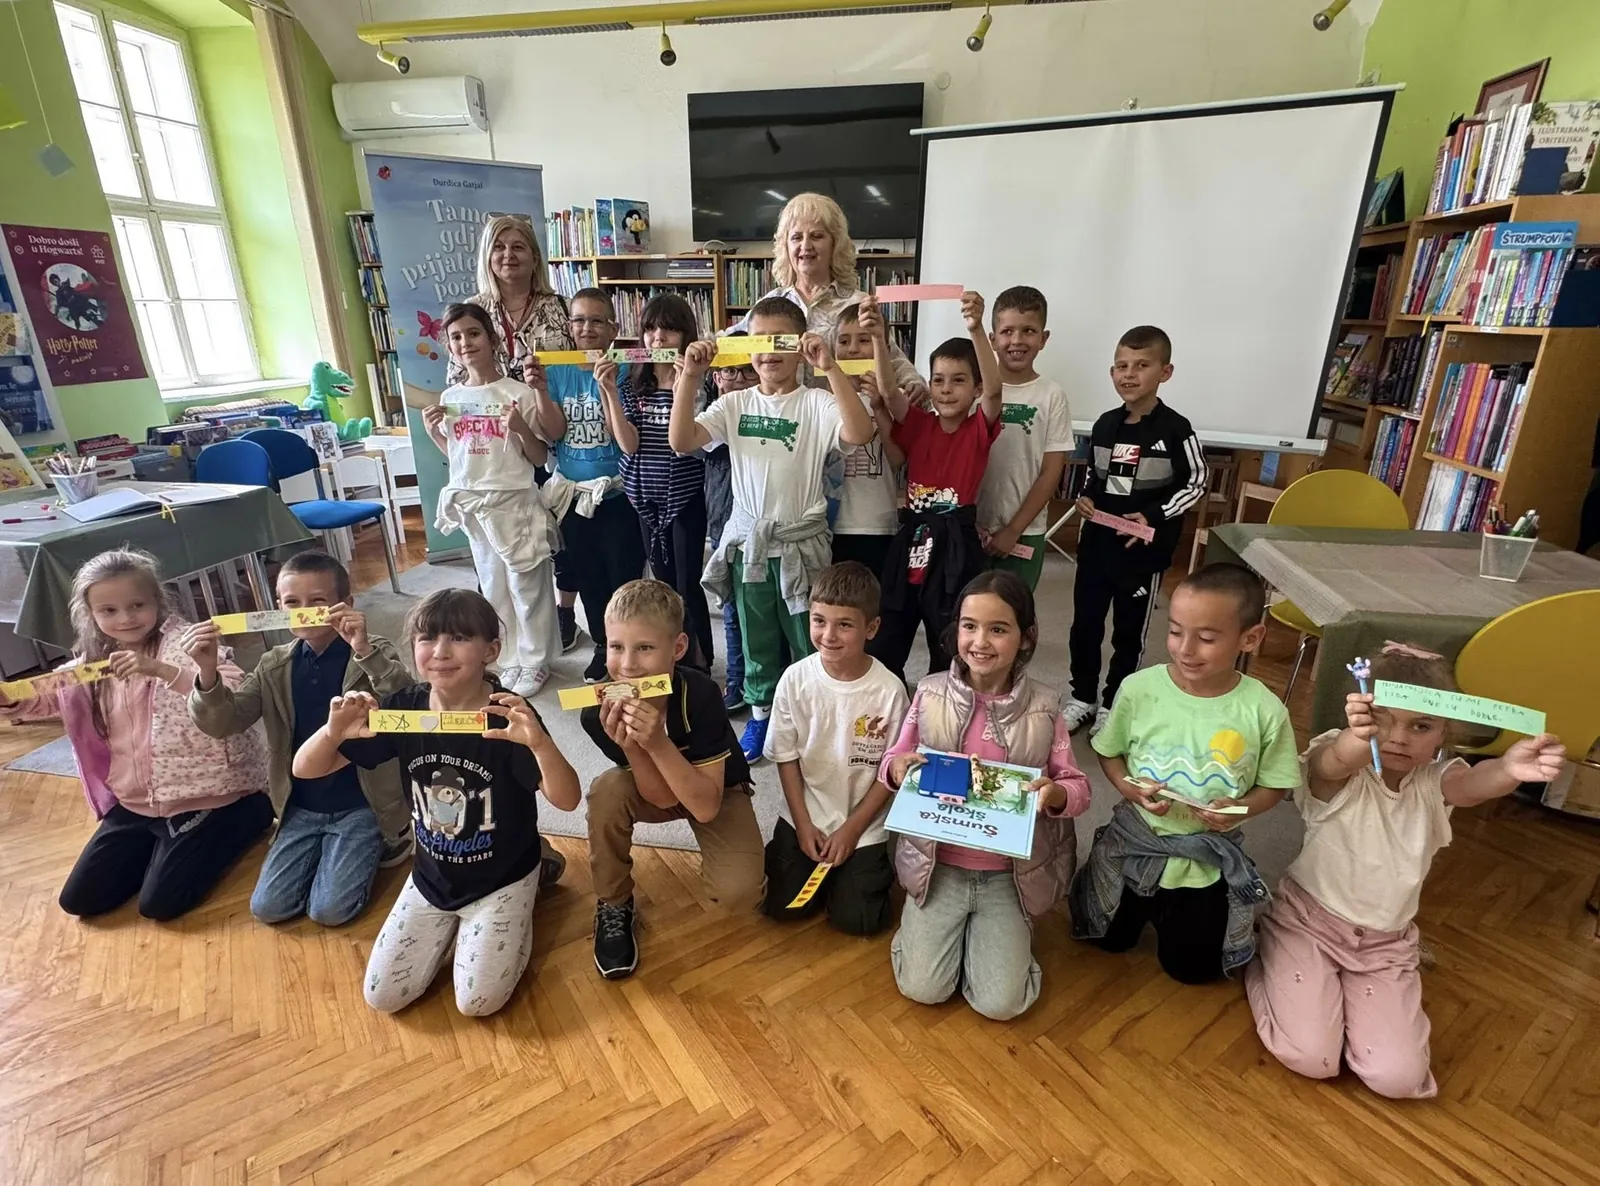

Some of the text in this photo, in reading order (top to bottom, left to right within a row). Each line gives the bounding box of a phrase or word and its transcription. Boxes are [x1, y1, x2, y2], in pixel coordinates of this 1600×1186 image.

[28, 234, 80, 247] Dobro došli
[439, 223, 480, 253] gdj
[31, 245, 84, 256] u Hogwarts!
[401, 253, 477, 289] prijate
[433, 274, 478, 303] poči
[46, 335, 98, 355] Harry Potter
[563, 402, 605, 422] ROCK
[453, 419, 504, 441] SPECIAL
[1112, 443, 1140, 457] NIKE
[408, 754, 493, 782] FOCUS ON YOUR DREAMS
[850, 757, 881, 766] POKÉMO
[937, 803, 986, 822] škola
[919, 811, 999, 838] Šumska
[431, 830, 494, 857] Angeles
[431, 850, 493, 864] FOR THE STARS
